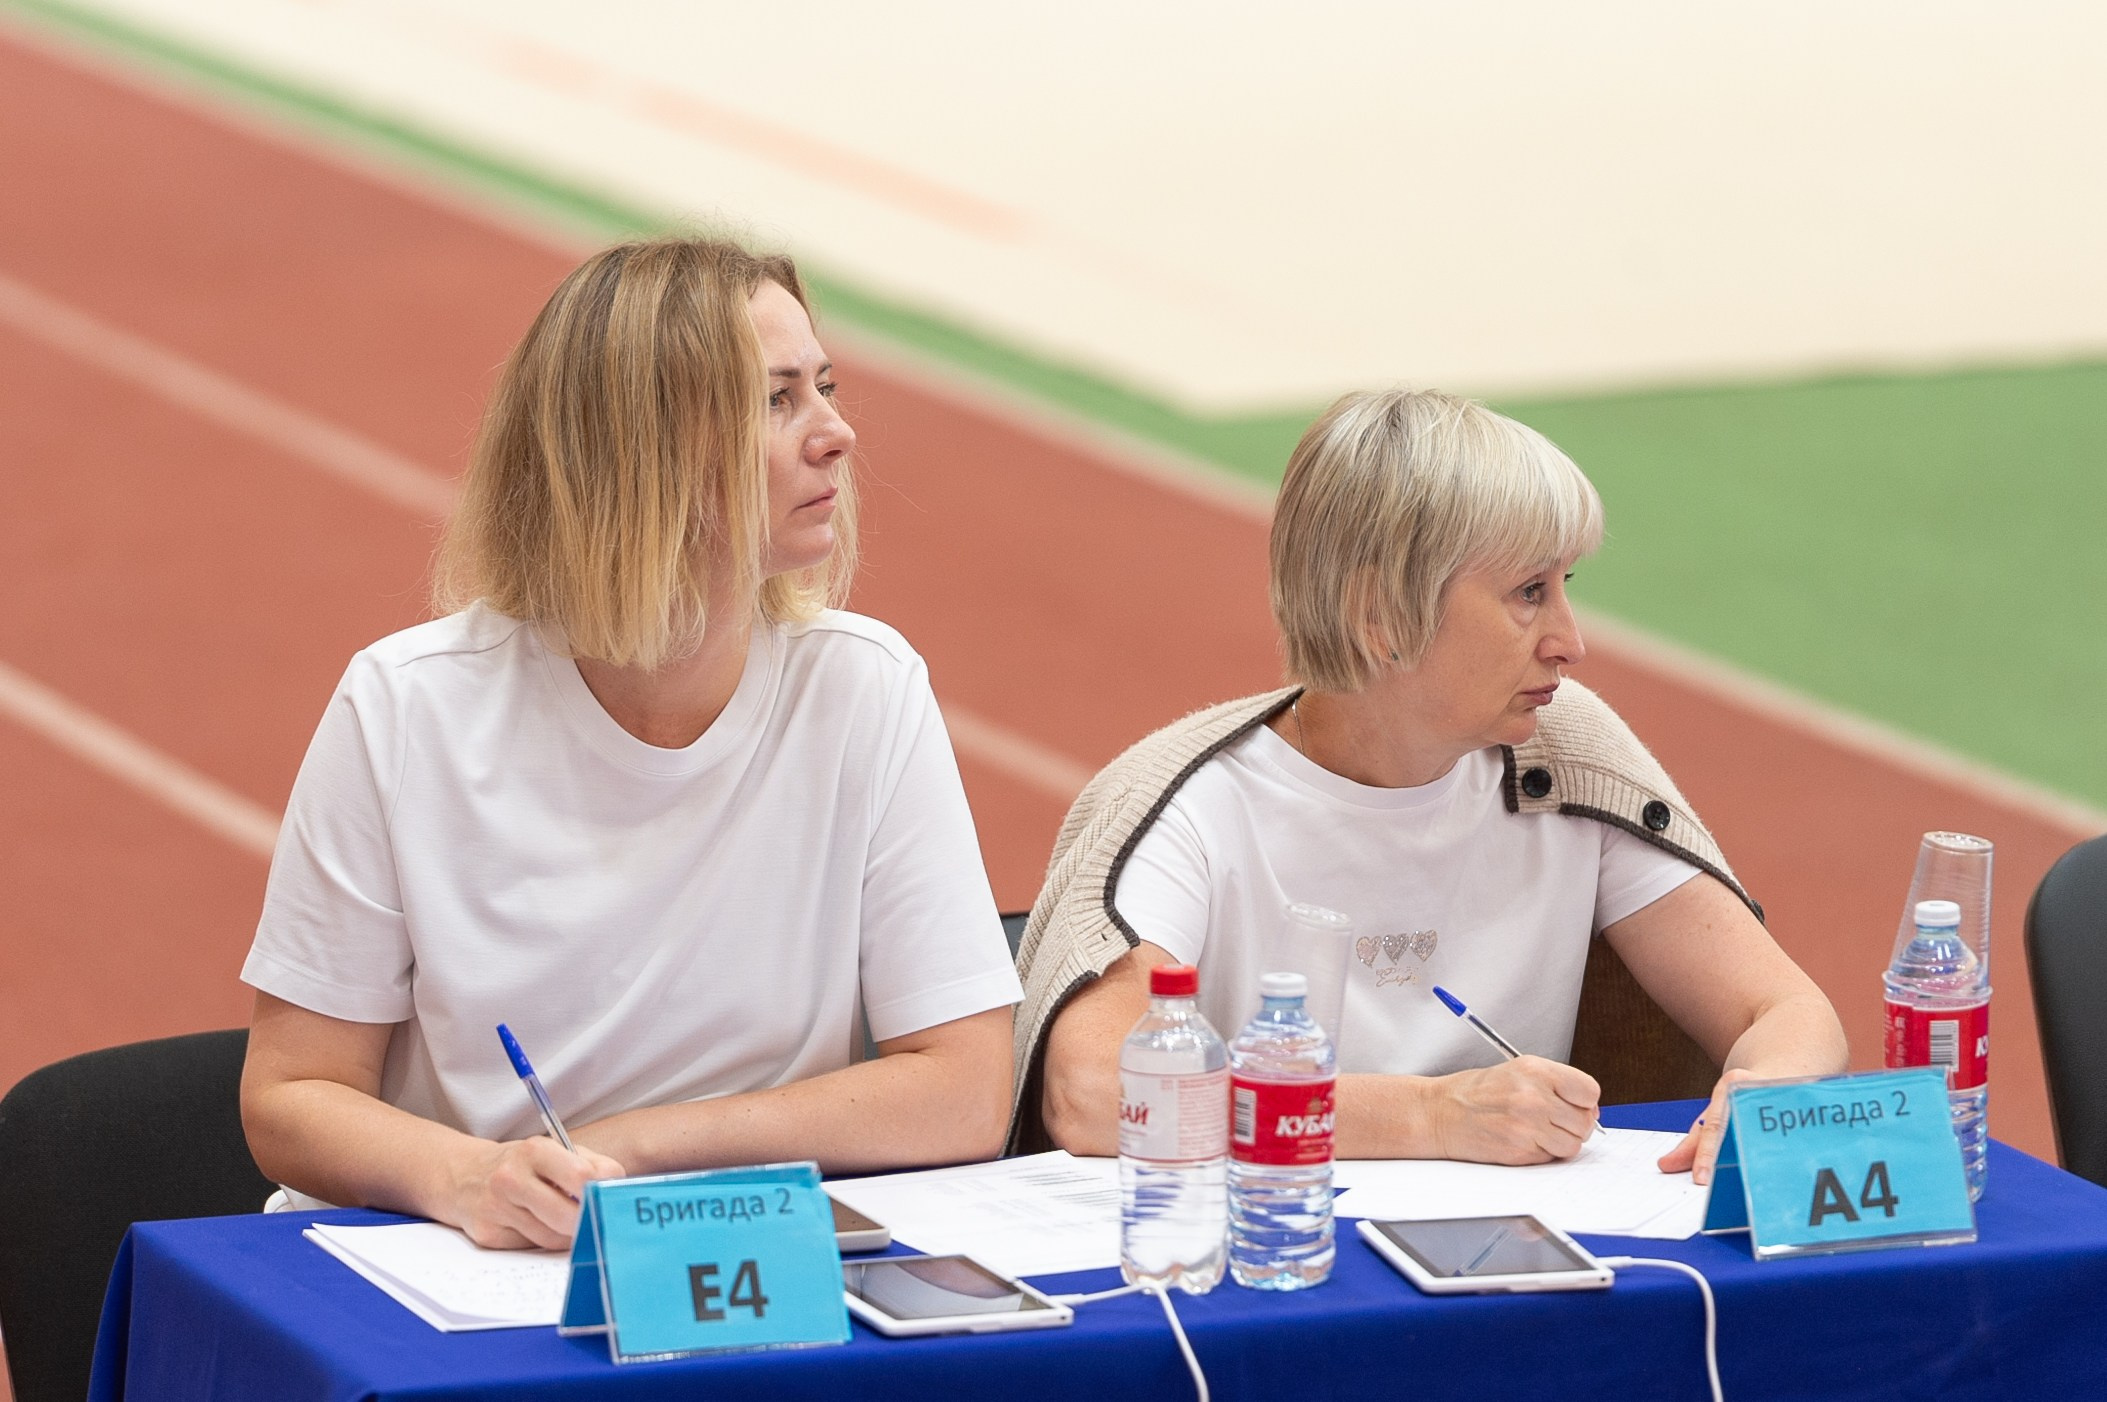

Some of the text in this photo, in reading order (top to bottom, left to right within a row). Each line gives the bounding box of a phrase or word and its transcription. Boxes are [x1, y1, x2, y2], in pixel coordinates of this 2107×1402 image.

[1759, 1091, 1910, 1135] Бригада 2
[635, 1188, 794, 1228] Бригада 2
